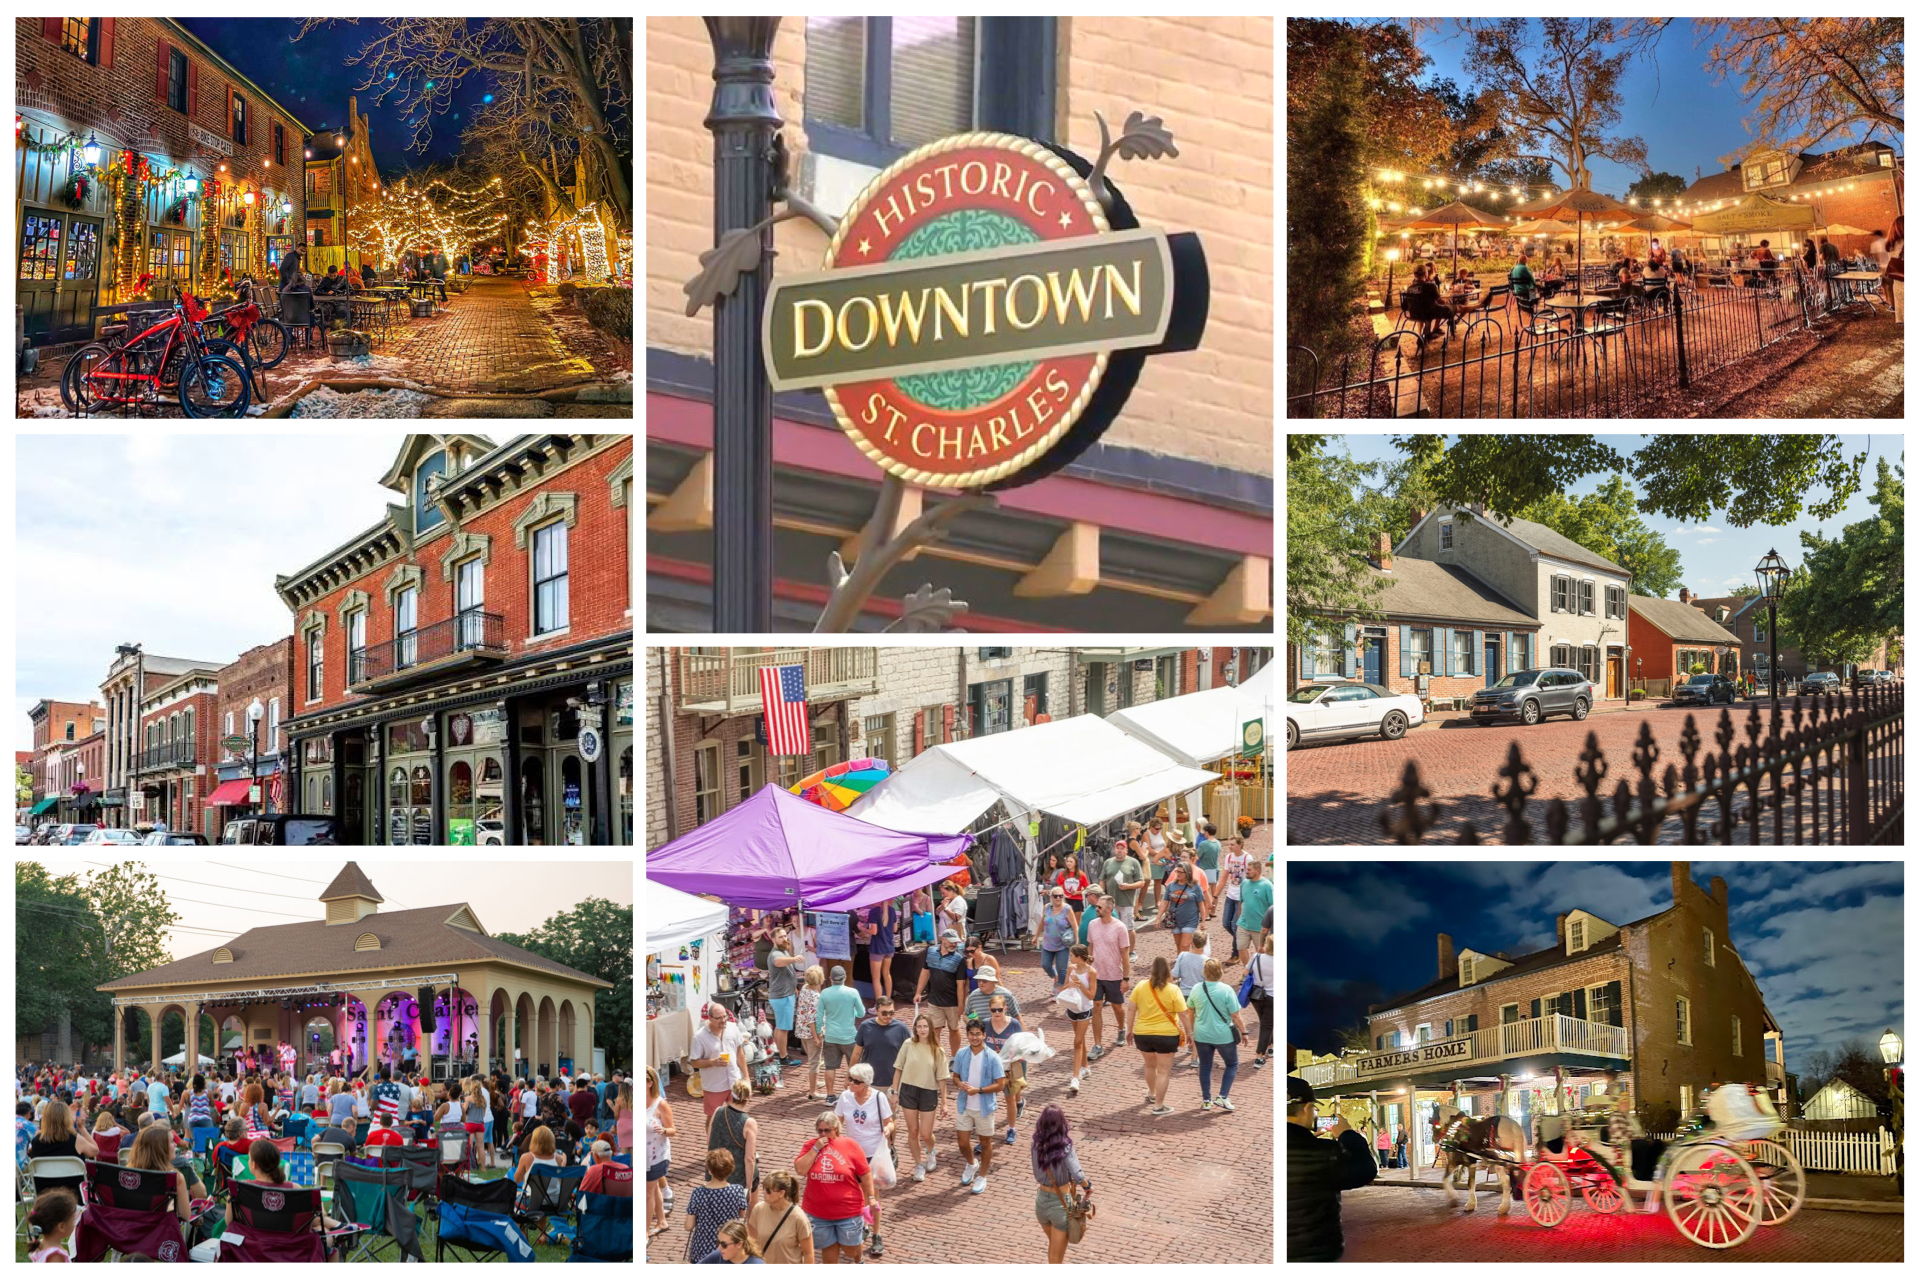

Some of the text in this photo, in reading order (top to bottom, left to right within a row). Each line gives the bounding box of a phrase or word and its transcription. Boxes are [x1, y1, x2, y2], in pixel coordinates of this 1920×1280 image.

[873, 161, 1056, 238] HISTORIC
[1743, 209, 1773, 218] SMOKE
[793, 260, 1143, 359] DOWNTOWN
[861, 368, 1071, 460] ST. CHARLES
[346, 1004, 395, 1022] Sant
[1361, 1051, 1420, 1071] FARMERS
[1423, 1041, 1466, 1061] HOME
[810, 1172, 845, 1182] CARDINALS
